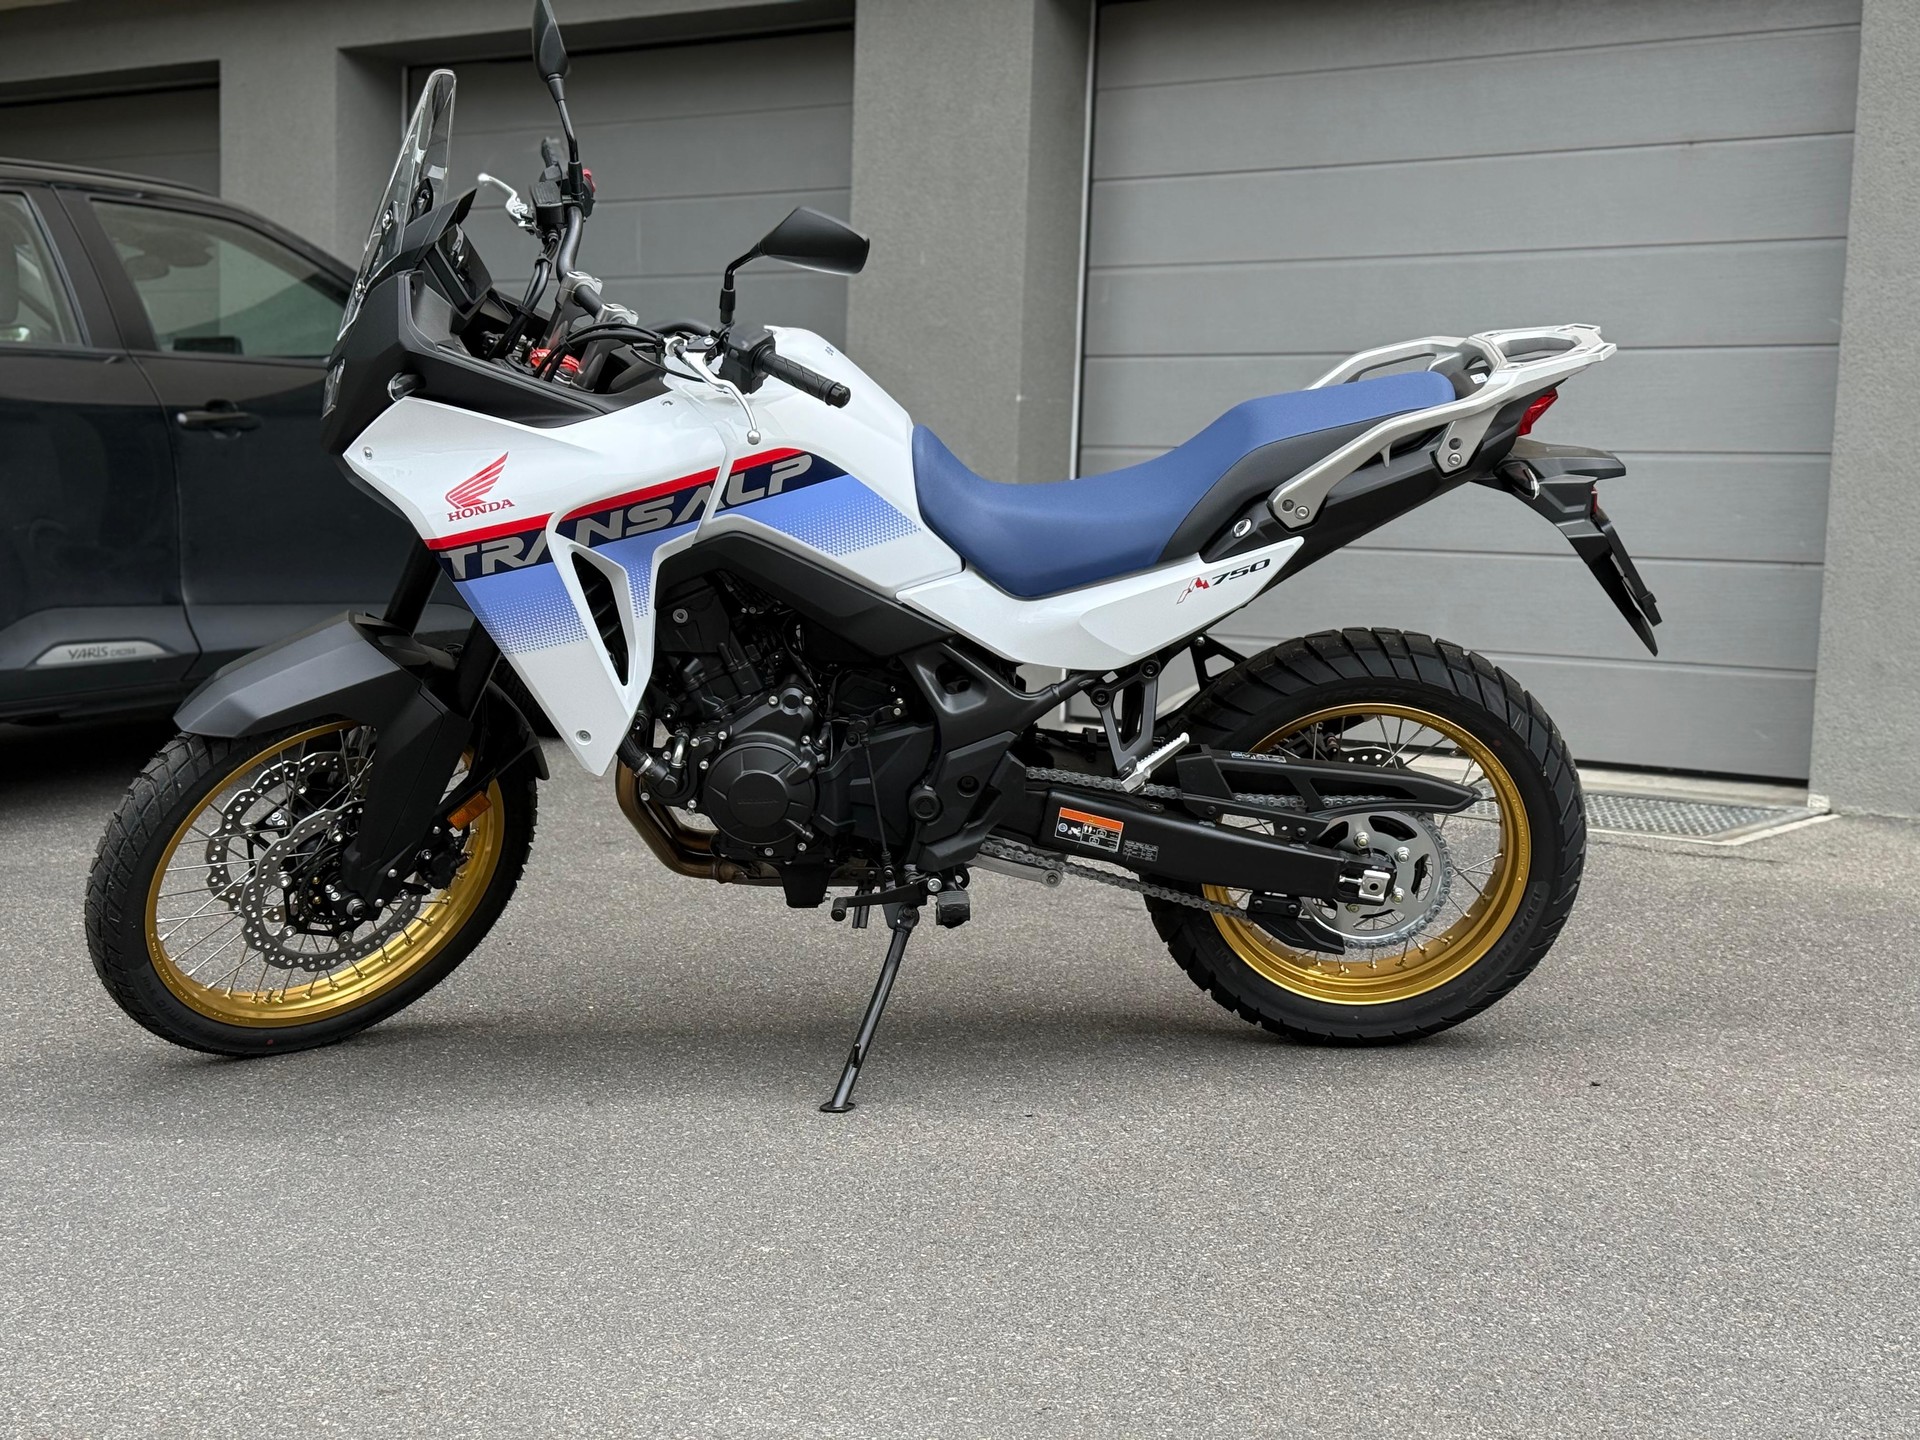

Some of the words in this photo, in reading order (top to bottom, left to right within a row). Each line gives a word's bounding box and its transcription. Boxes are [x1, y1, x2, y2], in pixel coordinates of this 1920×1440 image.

[439, 454, 813, 580] TRANSALP
[447, 499, 515, 521] HONDA
[1212, 559, 1271, 586] 750
[68, 646, 109, 660] YARIS
